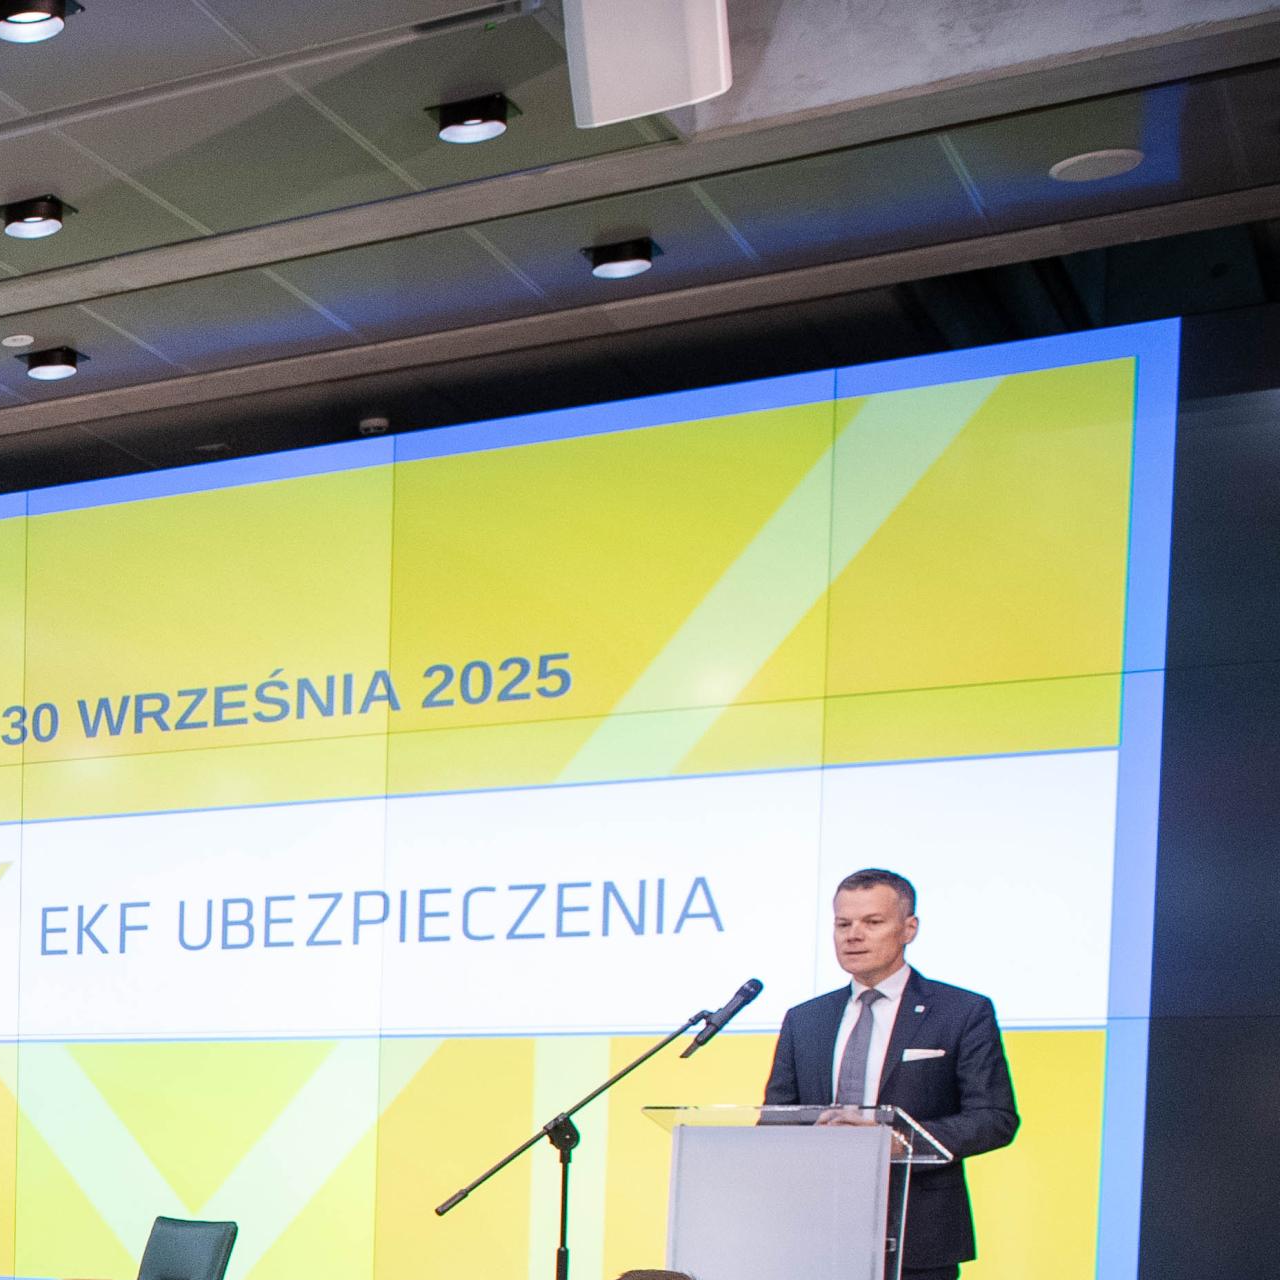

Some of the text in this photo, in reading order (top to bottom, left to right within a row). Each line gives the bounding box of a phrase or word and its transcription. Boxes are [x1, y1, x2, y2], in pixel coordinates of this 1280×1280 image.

[77, 668, 401, 738] WRZEŚNIA
[421, 652, 572, 708] 2025
[40, 876, 725, 956] EKF UBEZPIECZENIA
